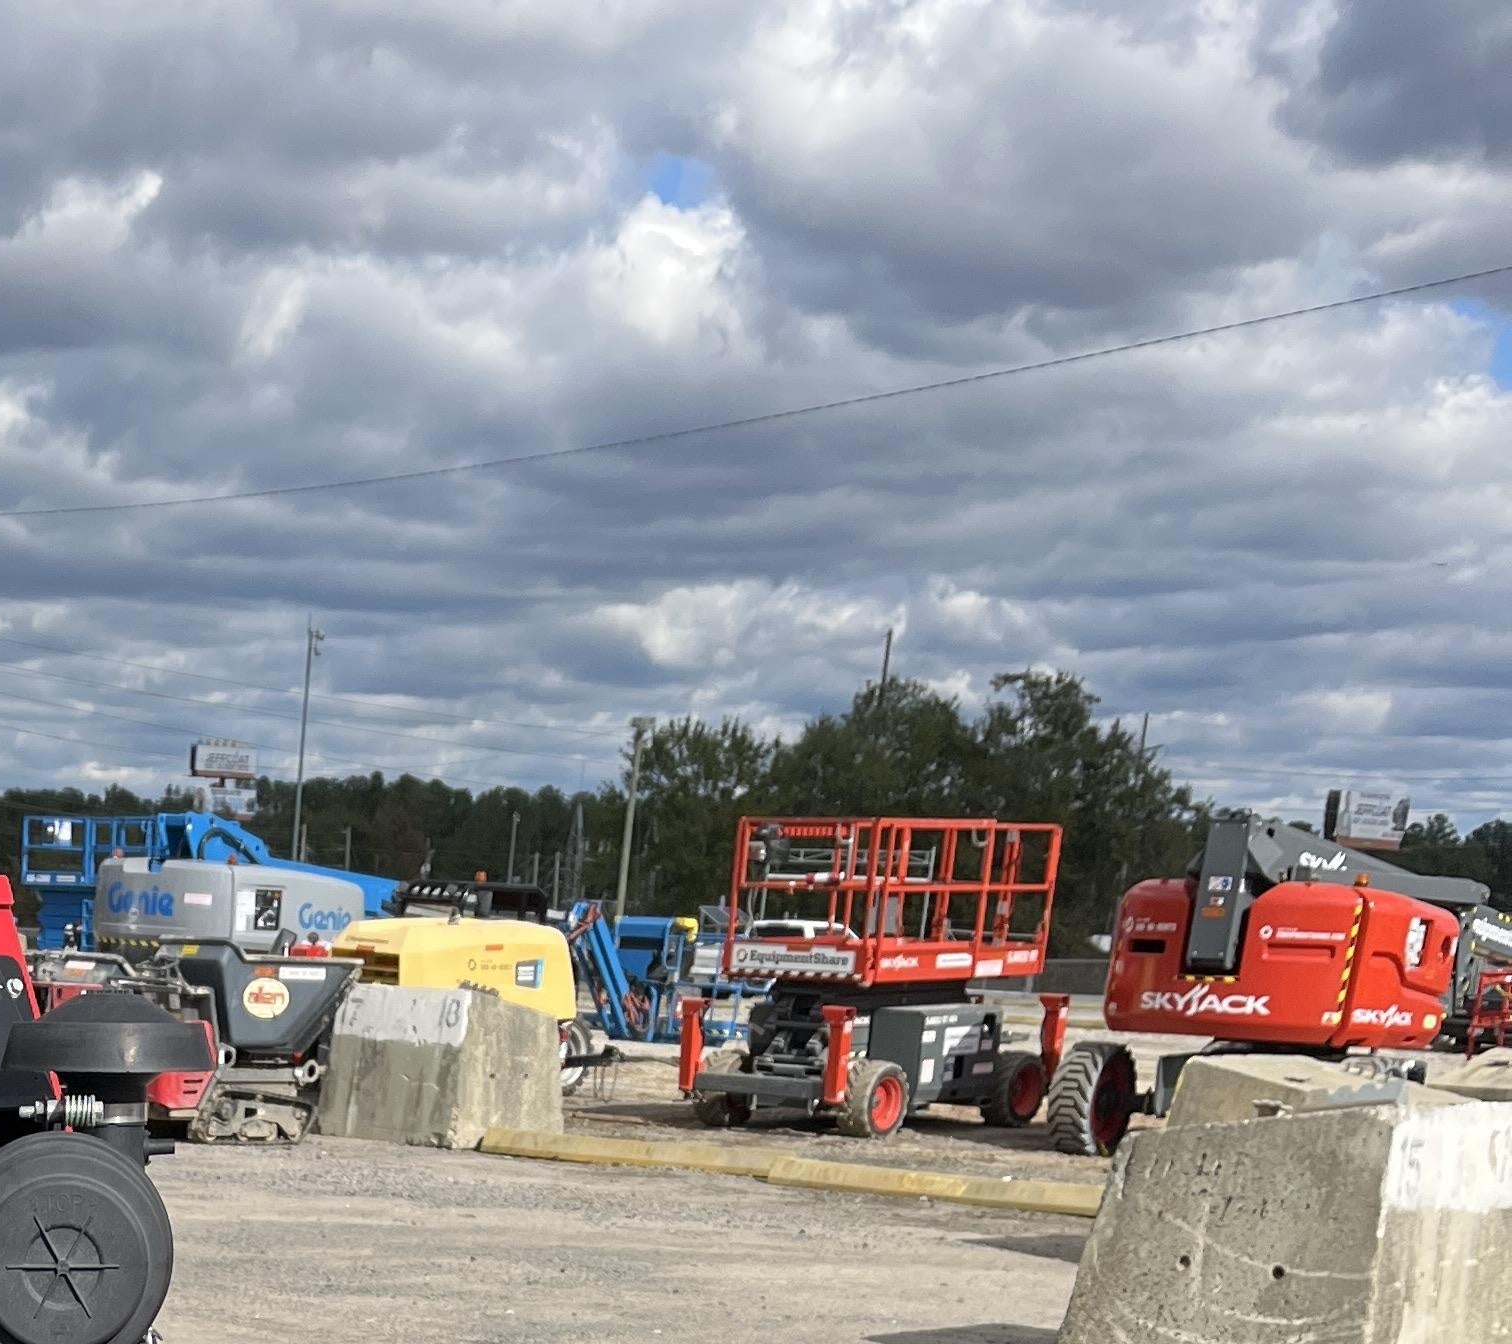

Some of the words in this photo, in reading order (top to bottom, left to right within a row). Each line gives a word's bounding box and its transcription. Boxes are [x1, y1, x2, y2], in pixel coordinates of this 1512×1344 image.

[107, 881, 175, 917] Genie
[298, 902, 352, 930] Genie
[749, 949, 849, 967] EquipmentShare
[1141, 983, 1271, 1017] SKYJACK
